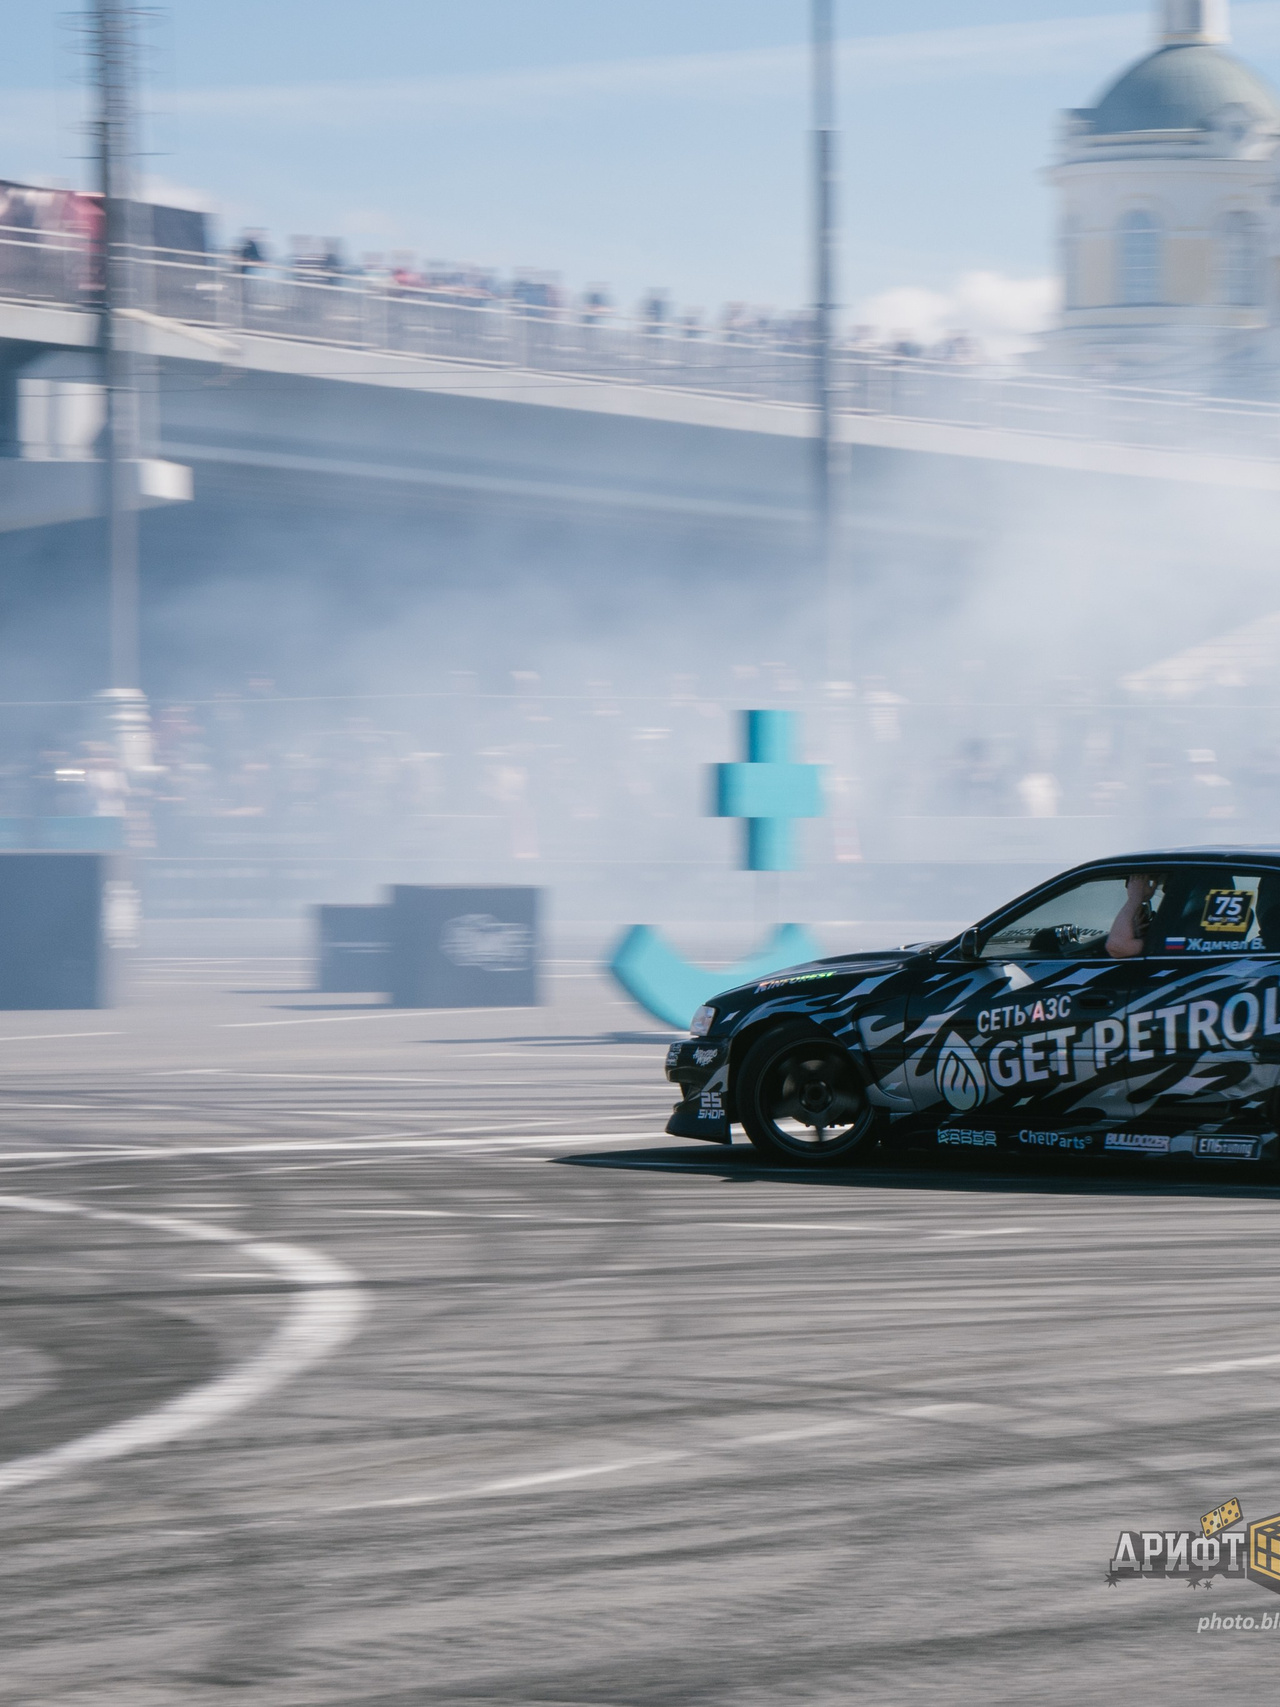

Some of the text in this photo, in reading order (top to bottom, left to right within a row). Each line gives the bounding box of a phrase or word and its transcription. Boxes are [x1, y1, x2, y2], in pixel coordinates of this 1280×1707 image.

[1215, 897, 1243, 916] 75
[977, 995, 1072, 1033] СЕТЬ АЗС
[989, 1026, 1077, 1087] GET
[701, 1092, 722, 1108] 25
[698, 1109, 725, 1119] SHOP
